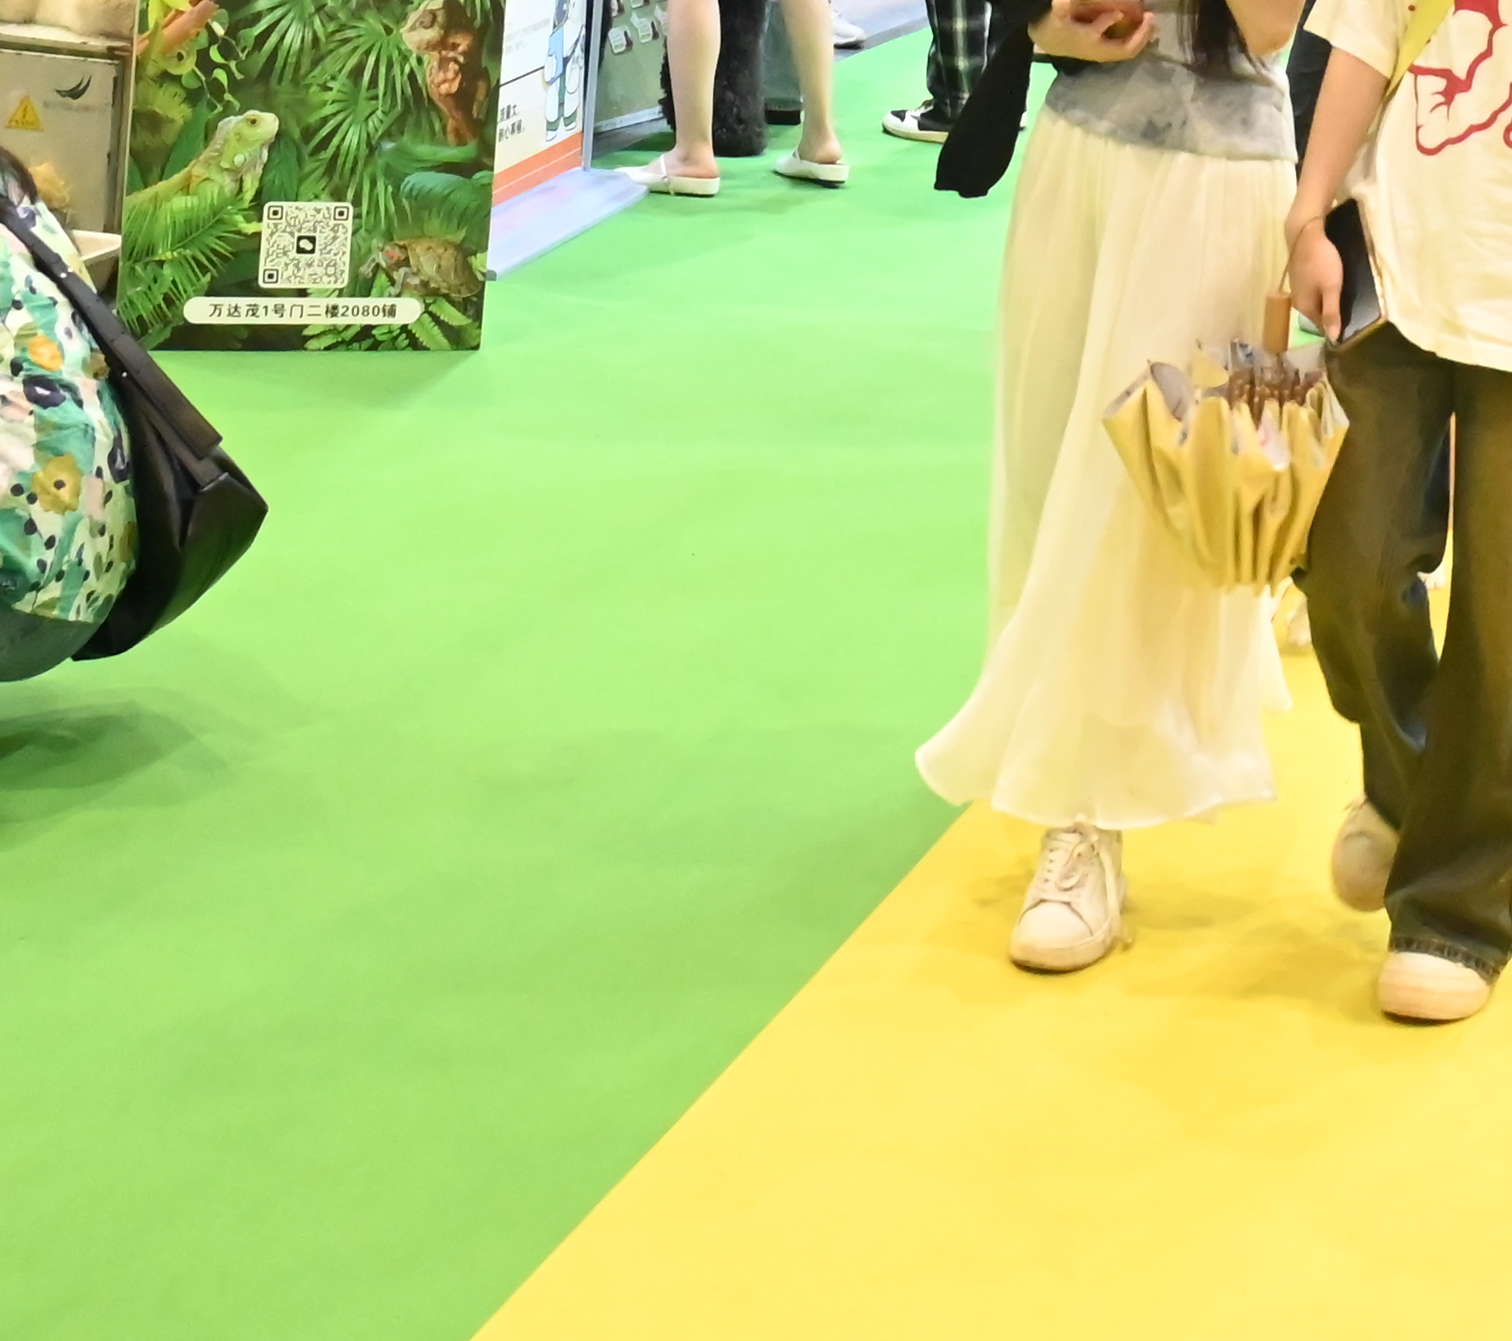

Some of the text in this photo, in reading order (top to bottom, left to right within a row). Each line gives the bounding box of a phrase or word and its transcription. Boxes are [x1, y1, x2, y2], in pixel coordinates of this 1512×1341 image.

[209, 302, 397, 320] 万达茂1号门二楼2080铺
